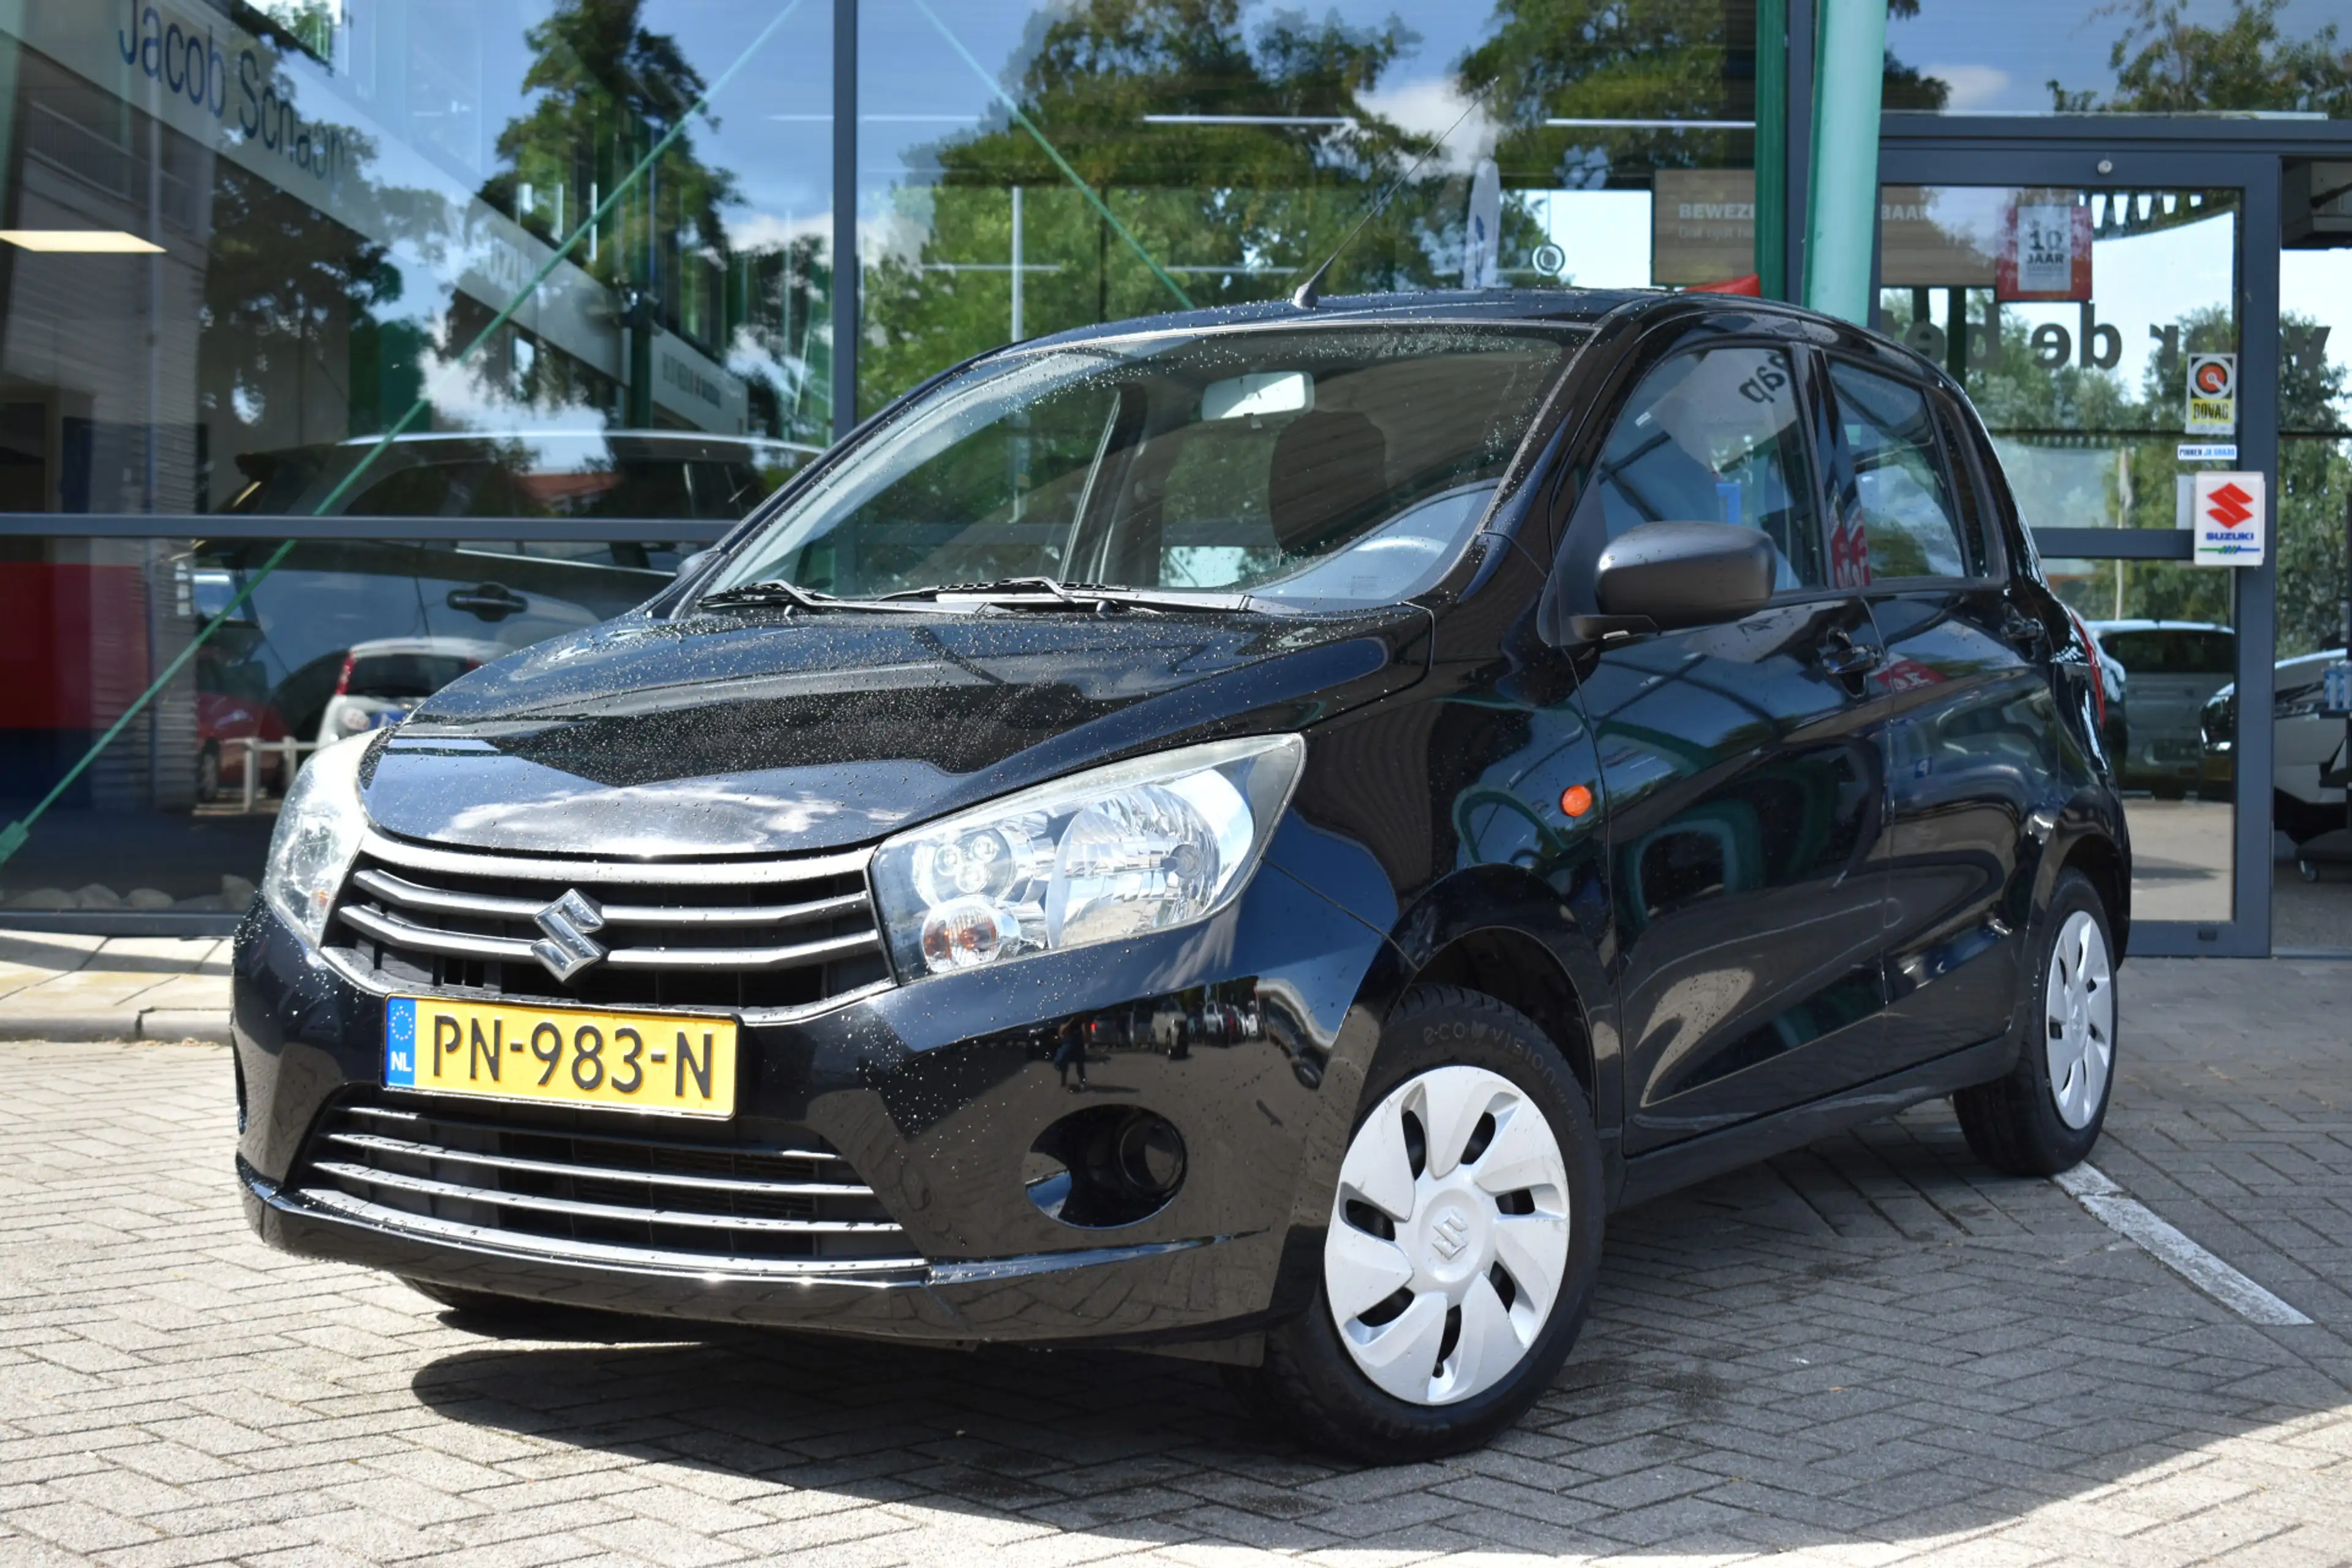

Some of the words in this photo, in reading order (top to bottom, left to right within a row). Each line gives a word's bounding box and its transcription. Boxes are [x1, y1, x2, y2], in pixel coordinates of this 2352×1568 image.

[118, 0, 226, 118] Jacob
[2030, 230, 2062, 251] 10
[2027, 253, 2065, 264] JAAR
[391, 1051, 412, 1072] NL
[433, 1015, 713, 1099] PN-983-N
